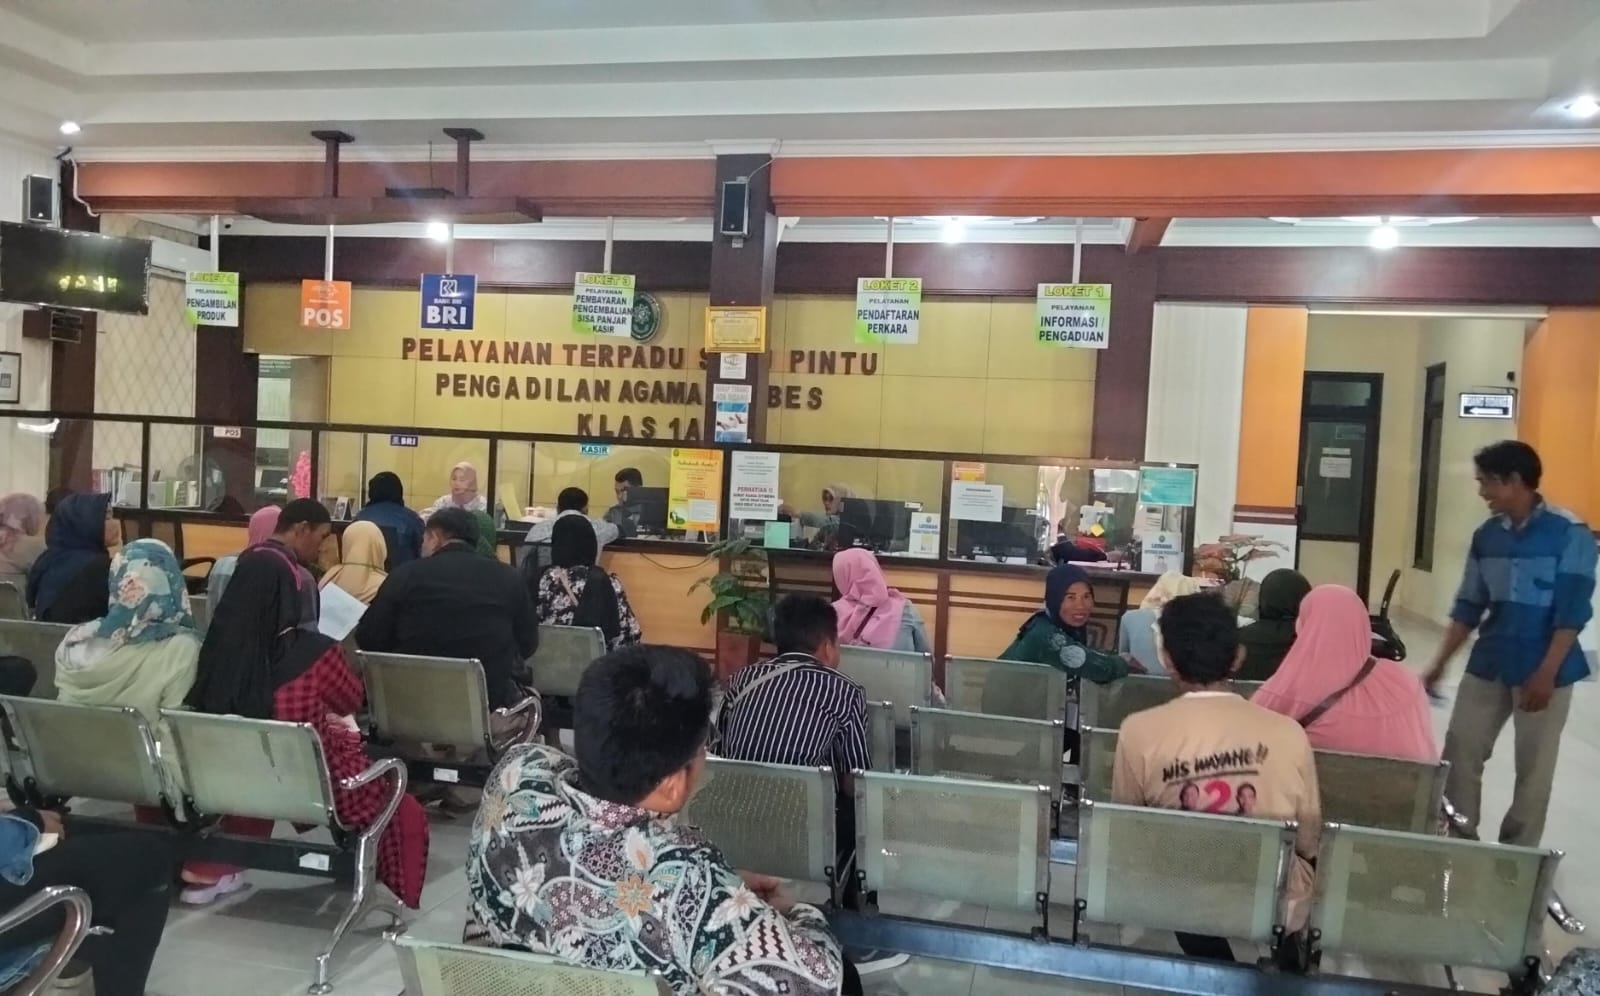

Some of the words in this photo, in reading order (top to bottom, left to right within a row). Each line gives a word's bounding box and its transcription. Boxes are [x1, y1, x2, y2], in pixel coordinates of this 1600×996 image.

[578, 274, 620, 286] LOKET
[622, 276, 632, 287] 3
[863, 279, 906, 292] LOKET
[908, 279, 919, 292] 2
[1044, 285, 1092, 298] LOKET
[1095, 286, 1105, 298] 1
[186, 297, 237, 309] PENGAMBILAN
[576, 294, 628, 305] PEMBAYARAN
[196, 310, 226, 321] PRODUK
[426, 305, 467, 325] BRI
[572, 304, 634, 315] PENGEMBALIAN
[857, 309, 920, 321] PENDAFTARAN
[303, 307, 344, 327] POS
[577, 314, 595, 323] SISA
[597, 315, 628, 325] PANJAR
[1040, 315, 1099, 328] INFORMASI
[592, 325, 615, 334] KASIR
[867, 323, 908, 335] PERKARA
[1038, 330, 1104, 342] PENGADUAN
[402, 337, 552, 365] PELAYANAN
[562, 344, 684, 370] TERPADU
[790, 350, 878, 376] PINTU
[436, 373, 611, 403] PENGADILAN
[618, 379, 703, 406] AGAMA
[225, 429, 240, 437] POS
[577, 413, 657, 439] KLAS
[668, 417, 701, 441] 1A
[400, 436, 416, 446] BRI
[581, 445, 608, 454] KASIR
[1203, 779, 1232, 812] 2
